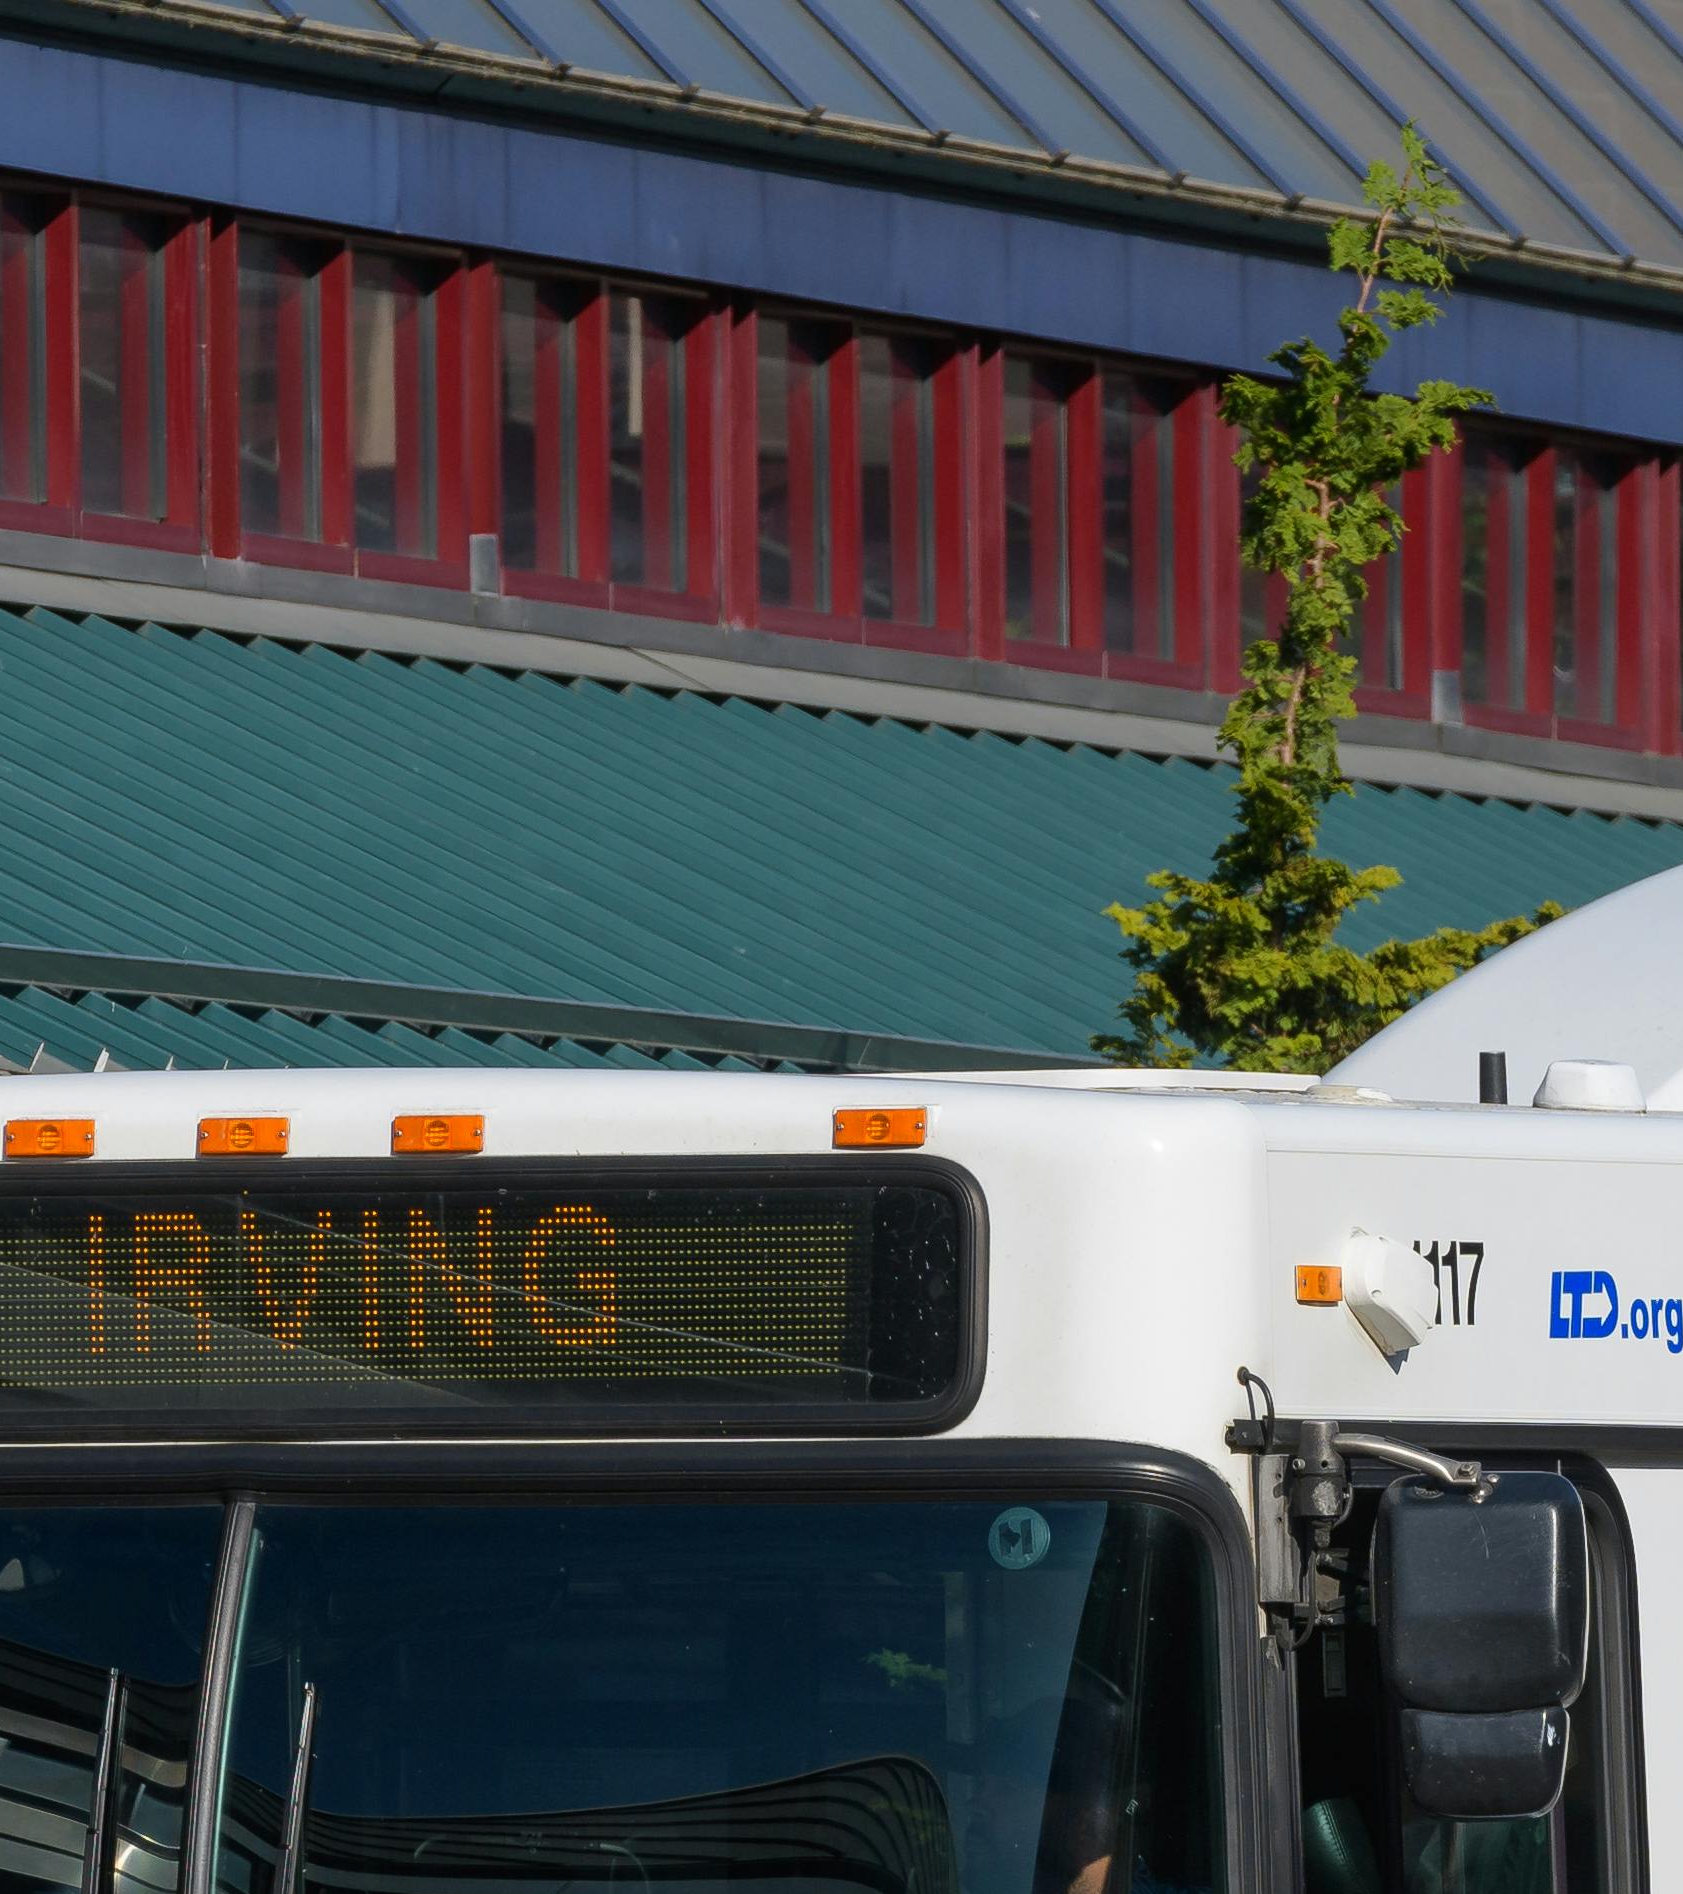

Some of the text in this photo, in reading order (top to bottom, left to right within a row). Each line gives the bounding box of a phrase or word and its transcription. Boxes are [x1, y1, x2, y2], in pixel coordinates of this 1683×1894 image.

[87, 1205, 618, 1357] IRVING
[1413, 1240, 1485, 1326] 117
[1549, 1270, 1683, 1355] LTD.org
